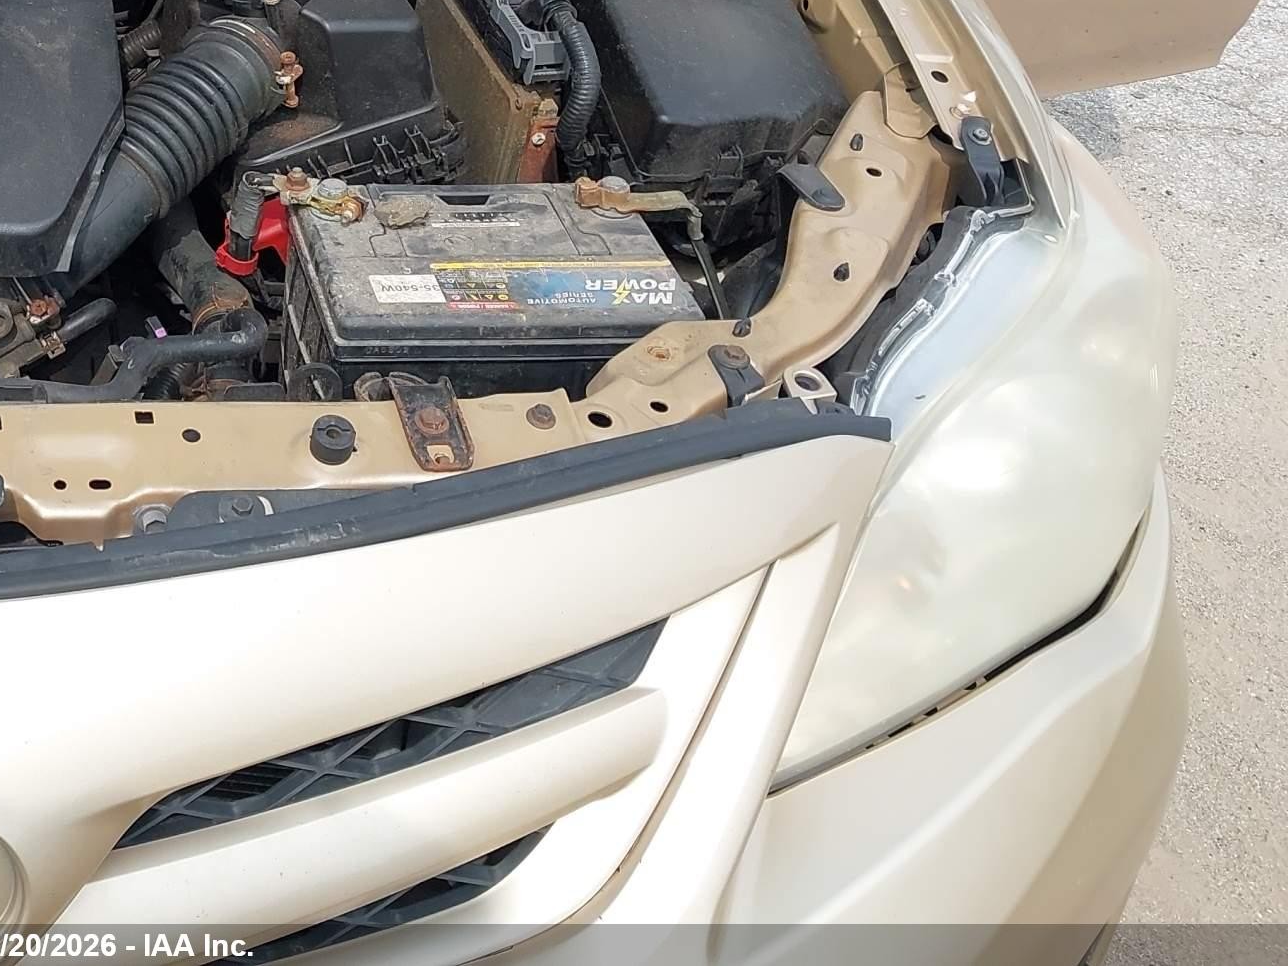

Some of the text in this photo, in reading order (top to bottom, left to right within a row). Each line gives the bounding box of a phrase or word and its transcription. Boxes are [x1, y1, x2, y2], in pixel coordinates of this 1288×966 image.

[381, 284, 441, 293] 35-540W
[585, 278, 676, 291] POWER
[612, 292, 673, 305] MAX
